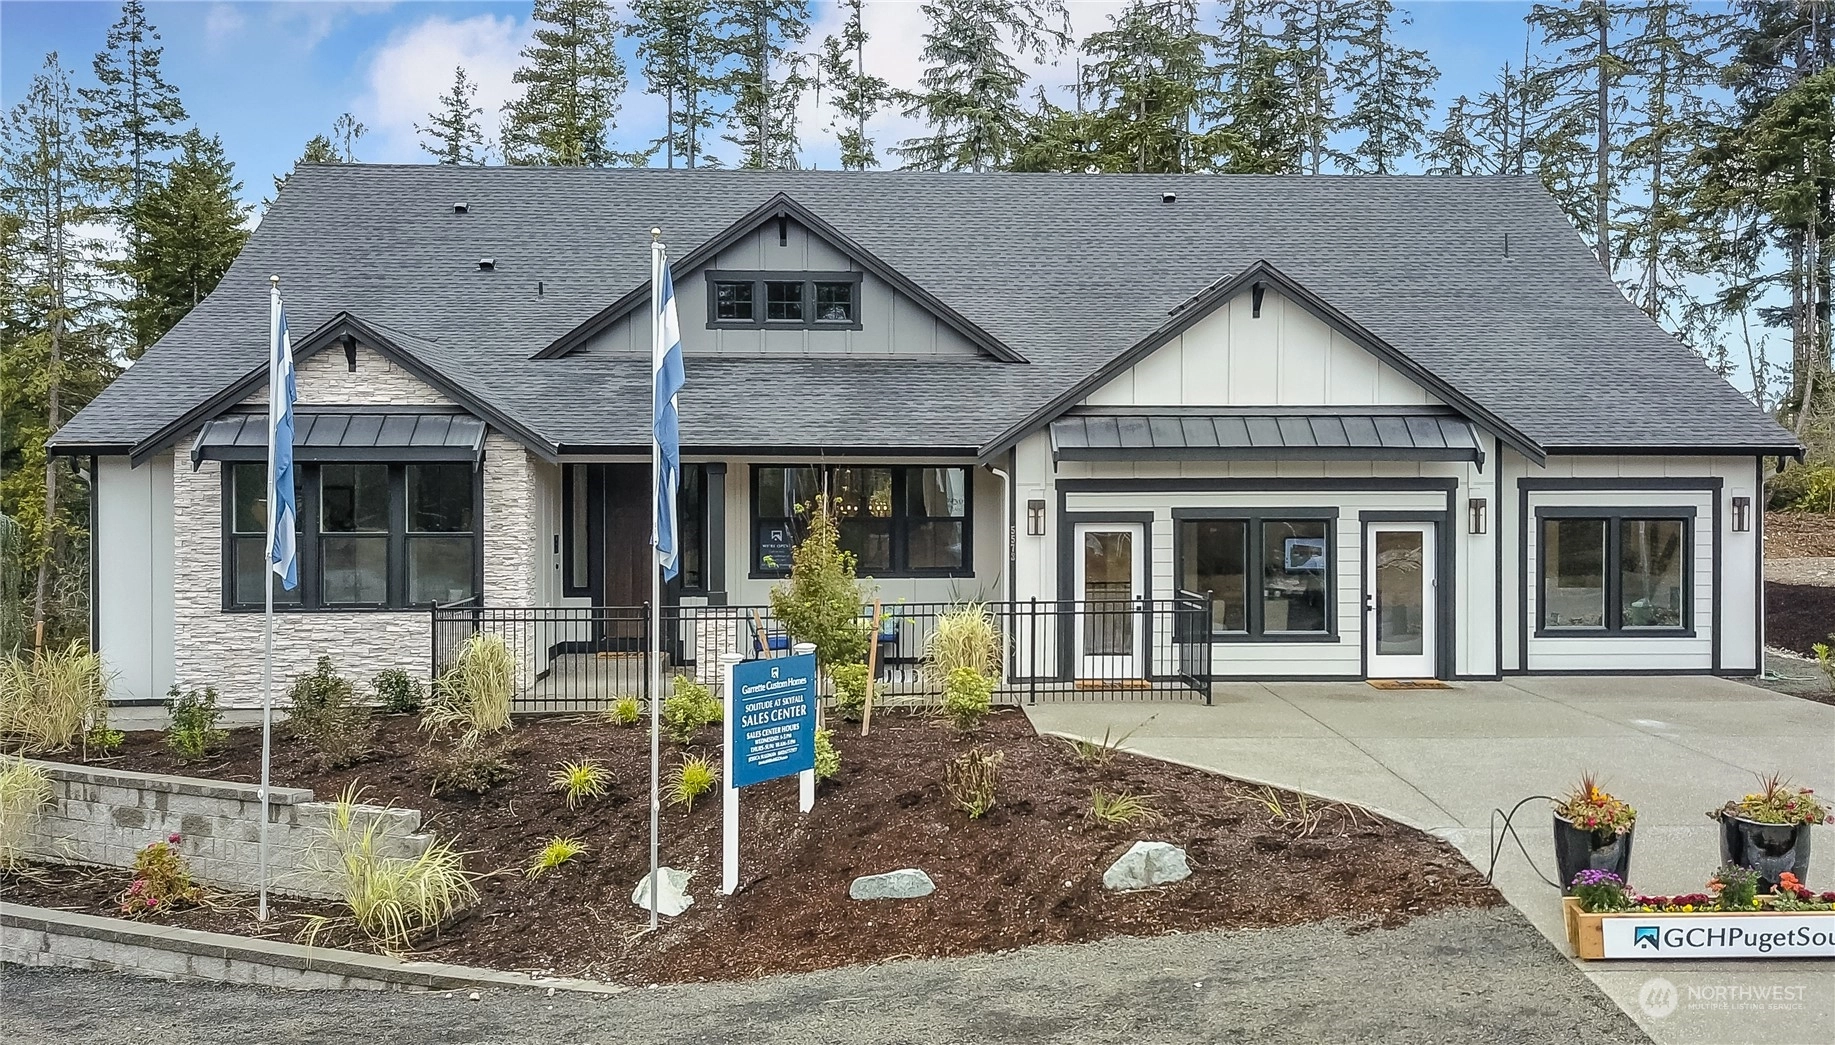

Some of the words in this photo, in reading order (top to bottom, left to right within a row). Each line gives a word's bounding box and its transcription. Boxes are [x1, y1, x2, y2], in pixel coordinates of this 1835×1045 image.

[766, 681, 788, 690] Custom
[788, 678, 806, 686] Homes
[746, 700, 773, 712] SOLITUDE
[774, 699, 781, 708] AT
[783, 695, 804, 705] SKYFALL
[742, 712, 769, 727] SALES
[771, 705, 806, 721] CENTER
[747, 731, 761, 739] SALES
[762, 727, 780, 736] CENTER
[782, 723, 799, 732] HOURS
